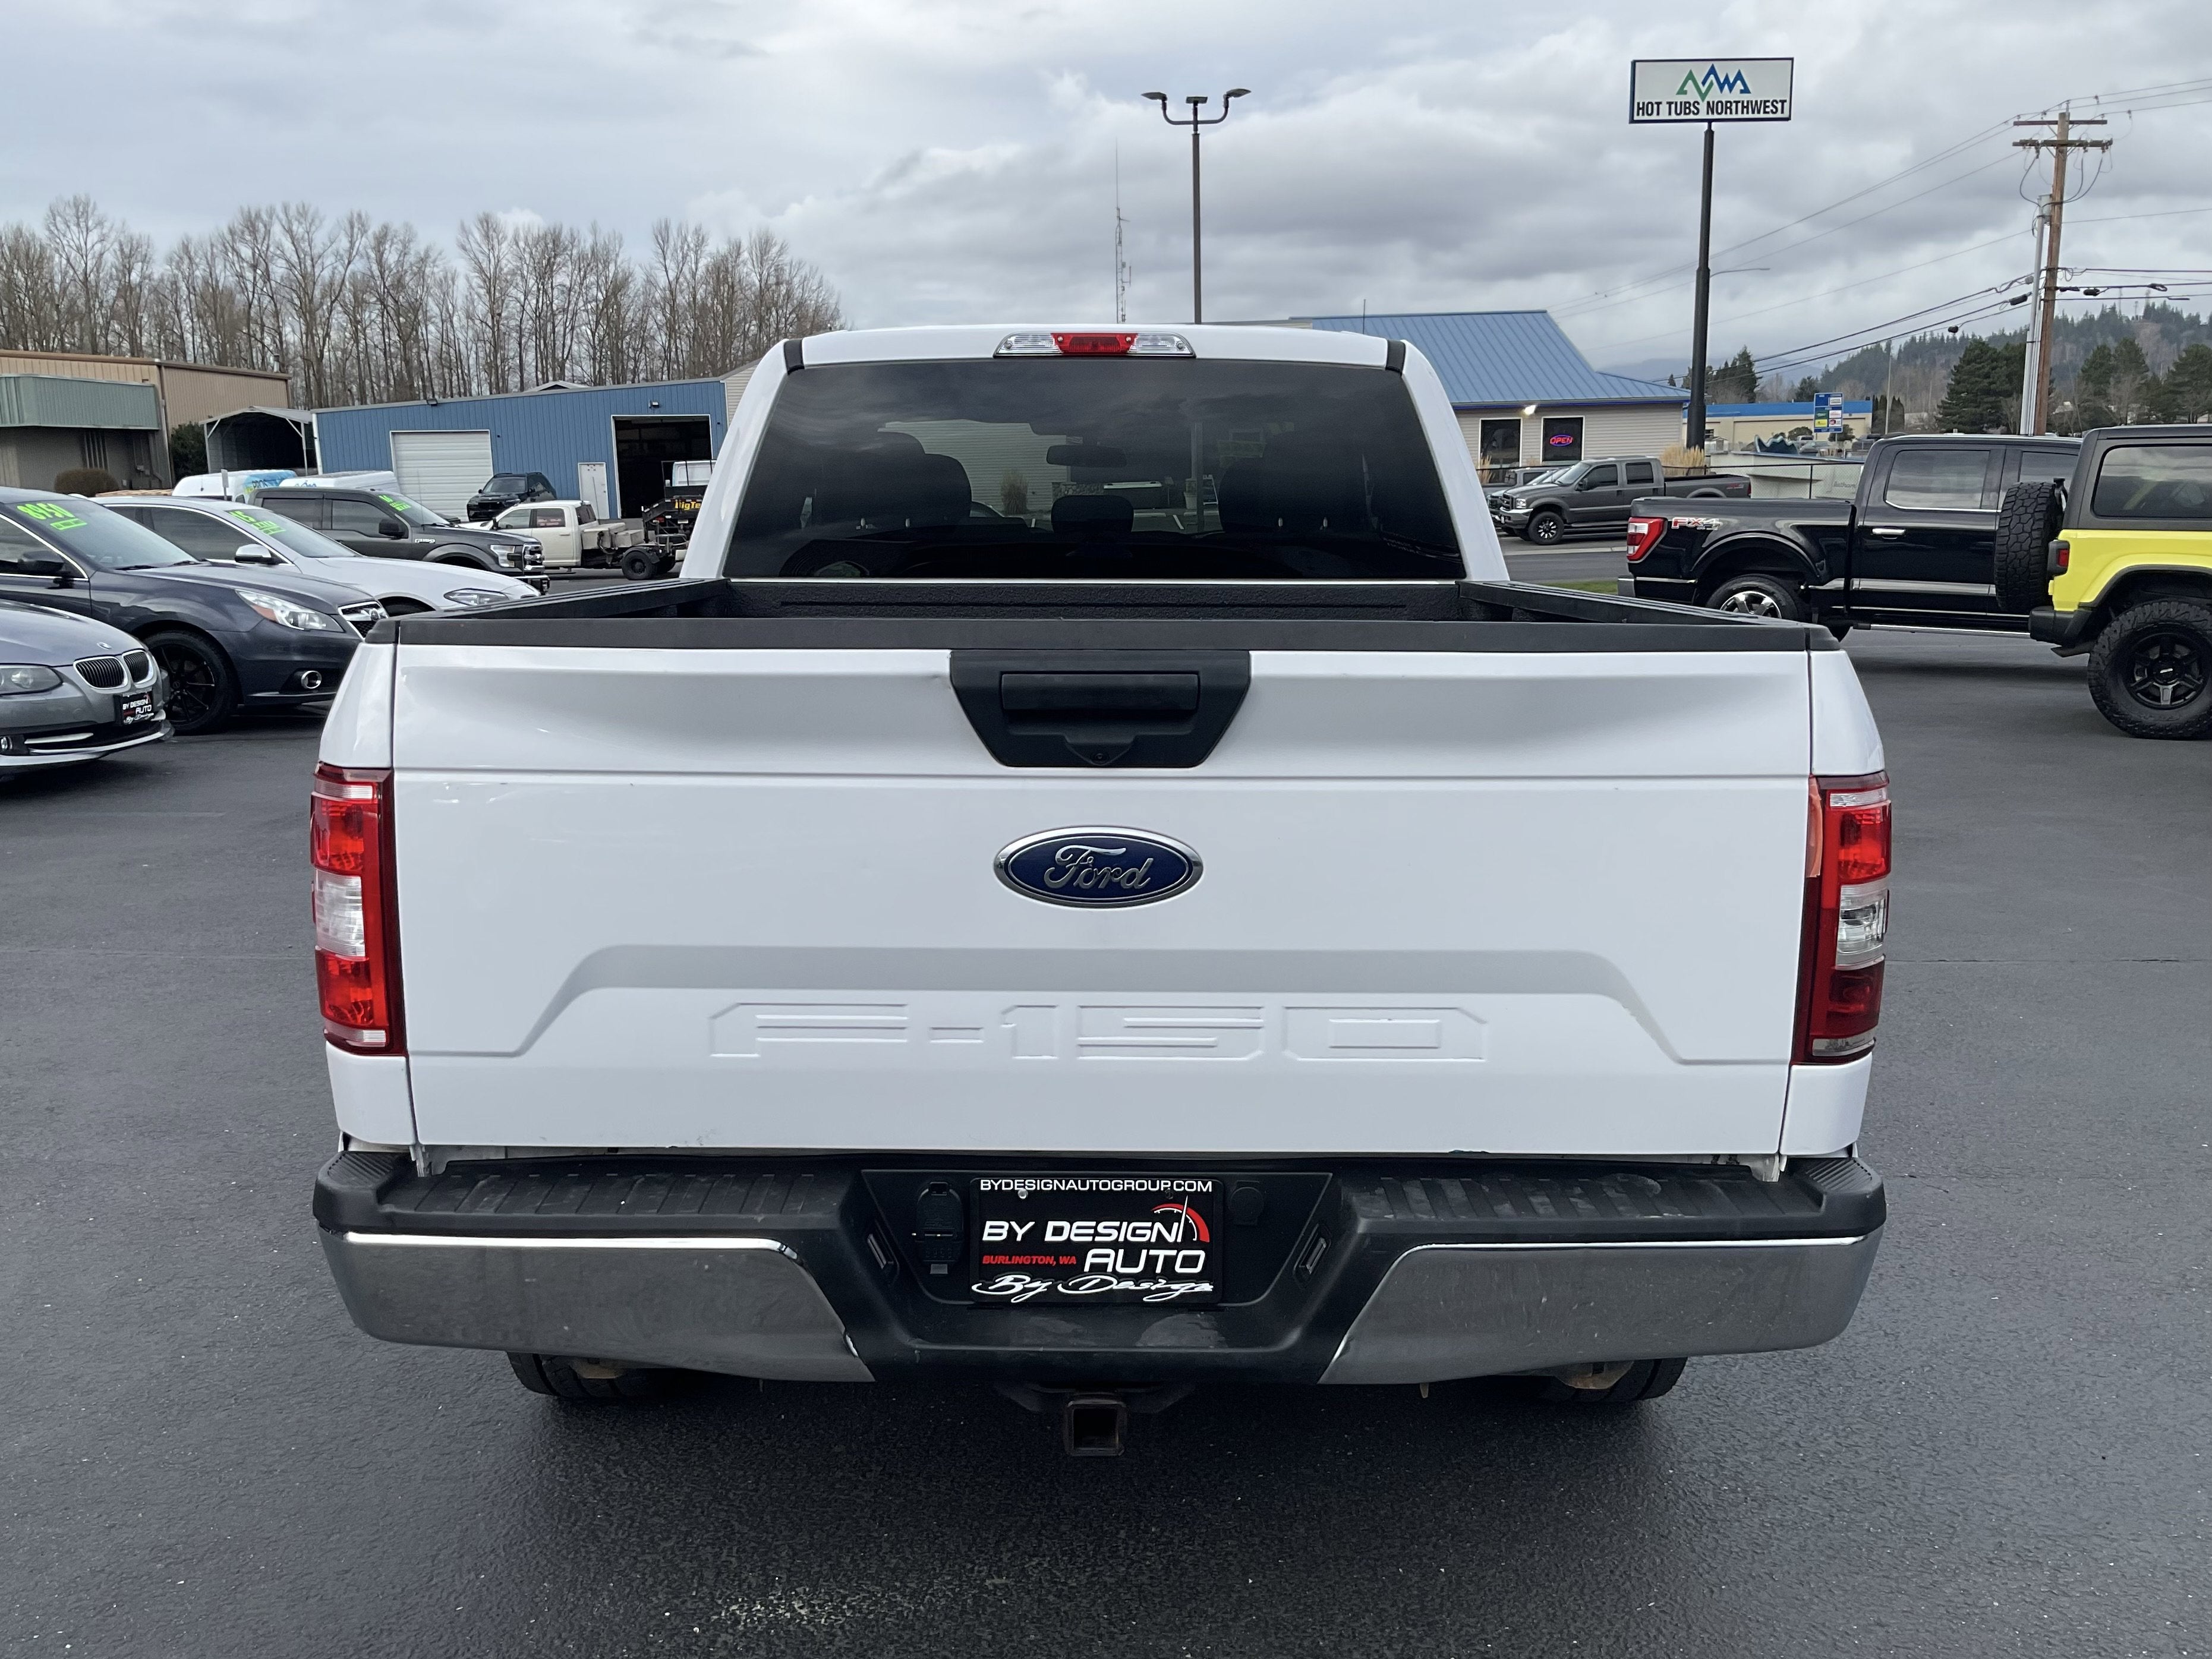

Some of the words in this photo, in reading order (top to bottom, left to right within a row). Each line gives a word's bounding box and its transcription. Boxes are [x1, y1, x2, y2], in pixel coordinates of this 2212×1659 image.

[1636, 102, 1662, 116] HOT
[1666, 101, 1700, 116] TUBS
[1706, 99, 1787, 115] NORTHWEST
[1671, 517, 1723, 530] FX4
[130, 698, 149, 708] DESIGN
[136, 705, 152, 714] AUTO
[1044, 845, 1154, 889] Ford
[709, 1002, 1488, 1062] F-150
[980, 1179, 1212, 1193] BYDESIGNAUTOGROUP.COM
[982, 1220, 1035, 1242] BY
[1044, 1221, 1183, 1243] DESIGN
[982, 1255, 1056, 1266] BURLINGTON,
[1060, 1256, 1077, 1265] WA
[1083, 1248, 1206, 1273] AUTO
[971, 1275, 1054, 1304] By
[1057, 1275, 1214, 1302] Design
